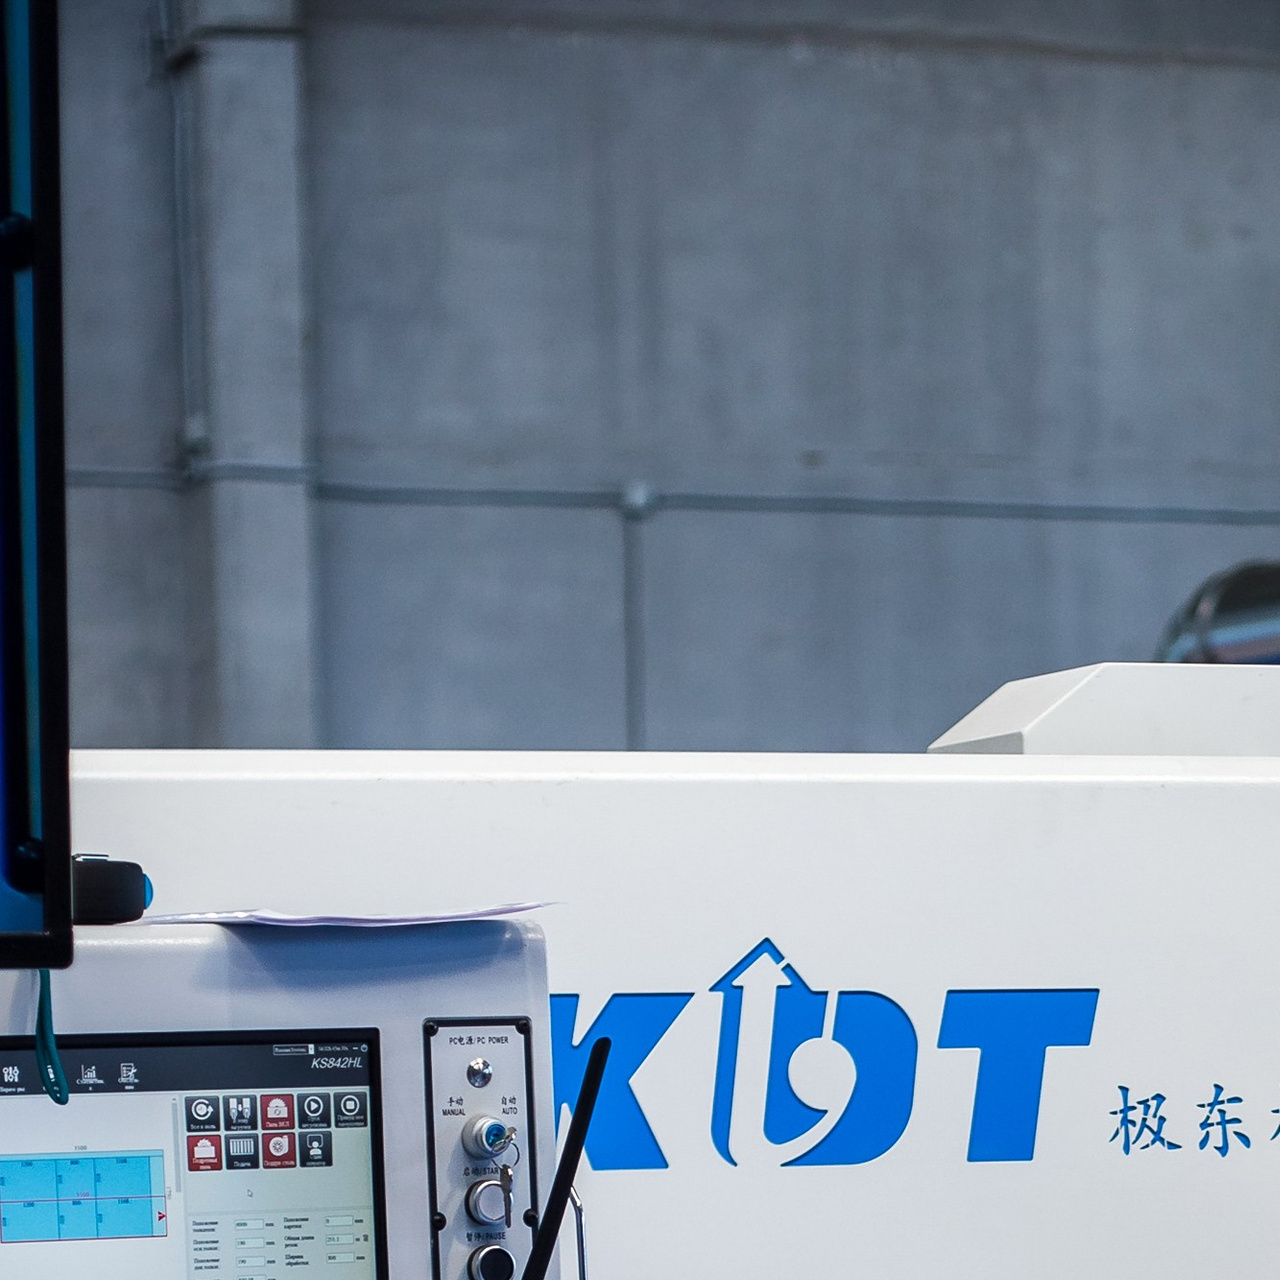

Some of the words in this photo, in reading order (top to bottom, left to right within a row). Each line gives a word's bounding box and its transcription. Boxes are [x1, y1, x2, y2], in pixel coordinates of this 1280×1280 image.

[488, 1036, 509, 1044] POWER
[549, 940, 1100, 1169] KDT
[311, 1057, 363, 1069] KS842HL
[447, 1097, 464, 1107] 手动
[501, 1096, 517, 1106] 自动
[502, 1107, 518, 1115] AUTO
[463, 1167, 499, 1176] 启动/STAR
